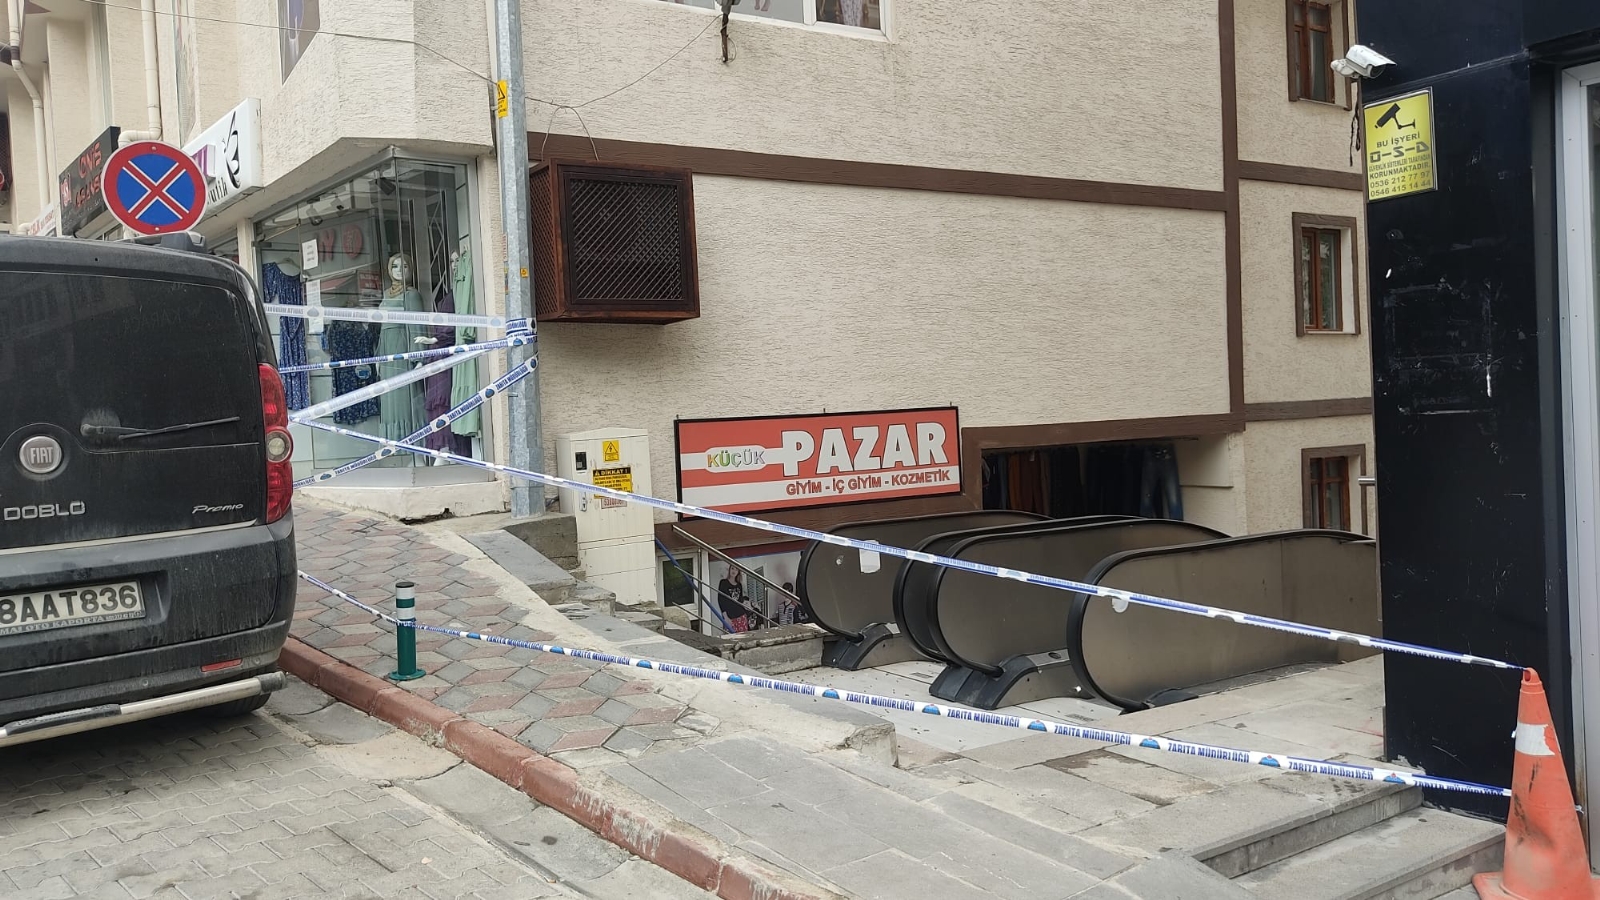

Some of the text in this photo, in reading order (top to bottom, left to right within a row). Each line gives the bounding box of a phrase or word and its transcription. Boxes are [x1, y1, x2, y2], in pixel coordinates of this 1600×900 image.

[1376, 131, 1420, 148] BU İŞYERİ
[1370, 179, 1389, 188] 0536
[1391, 176, 1406, 185] 212
[1408, 173, 1417, 181] 77
[207, 176, 228, 205] utik
[1370, 187, 1390, 197] 0546
[1391, 184, 1407, 193] 415
[30, 446, 54, 464] FIAT
[781, 421, 950, 477] PAZAR
[707, 448, 766, 469] KÜÇÜK
[786, 479, 823, 496] GİYİM
[832, 477, 845, 494] İÇ
[848, 474, 882, 491] GİYİM
[891, 468, 951, 487] KOZMETİK
[4, 500, 86, 521] DOBLO
[191, 503, 244, 514] Premio
[52, 615, 104, 628] KAPORTA
